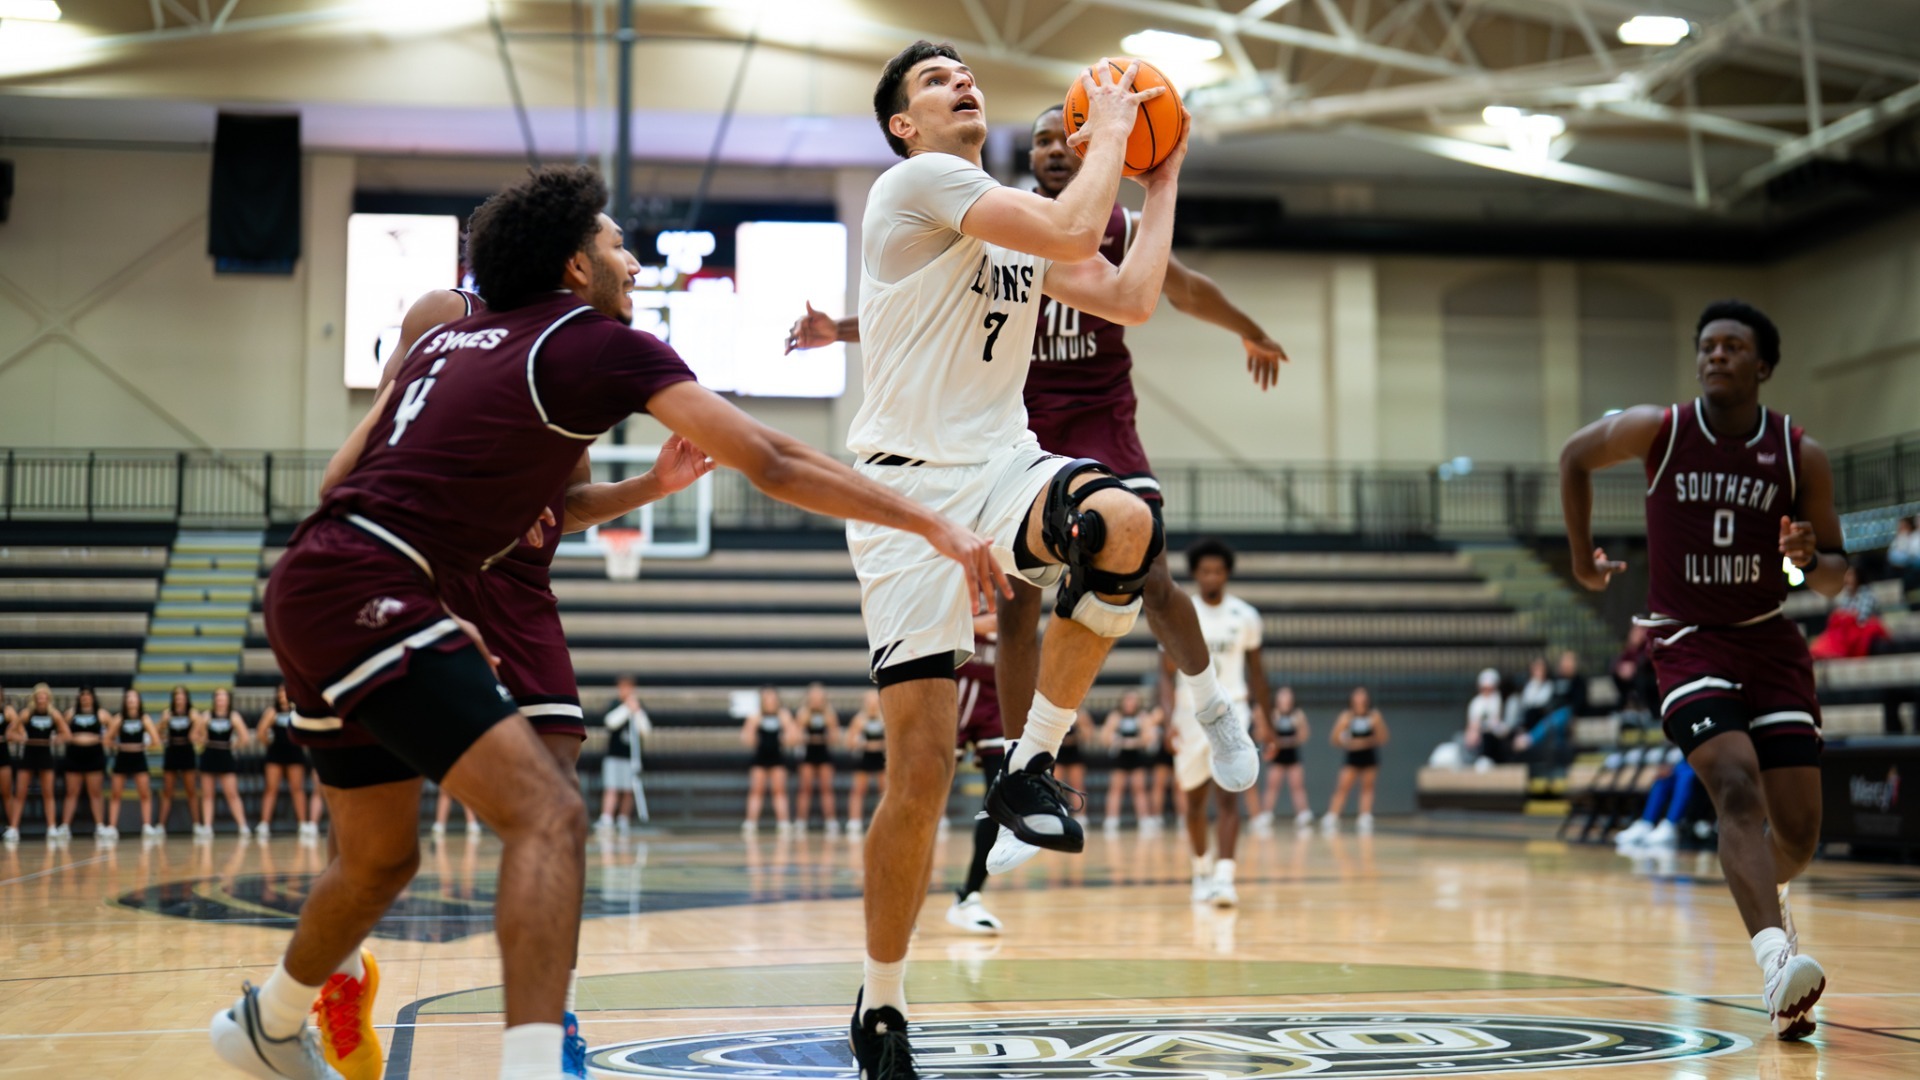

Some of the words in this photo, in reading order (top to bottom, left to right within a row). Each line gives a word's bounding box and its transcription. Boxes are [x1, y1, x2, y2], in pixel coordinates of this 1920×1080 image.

[971, 254, 1034, 304] LONS
[982, 310, 1009, 363] 7
[1044, 299, 1081, 337] 10
[423, 328, 510, 355] SYKES
[1031, 331, 1098, 362] LINOIS
[387, 357, 448, 447] 4
[1675, 471, 1779, 513] SOUTHERN
[1712, 508, 1735, 547] 0
[1685, 553, 1761, 585] ILLINOIS
